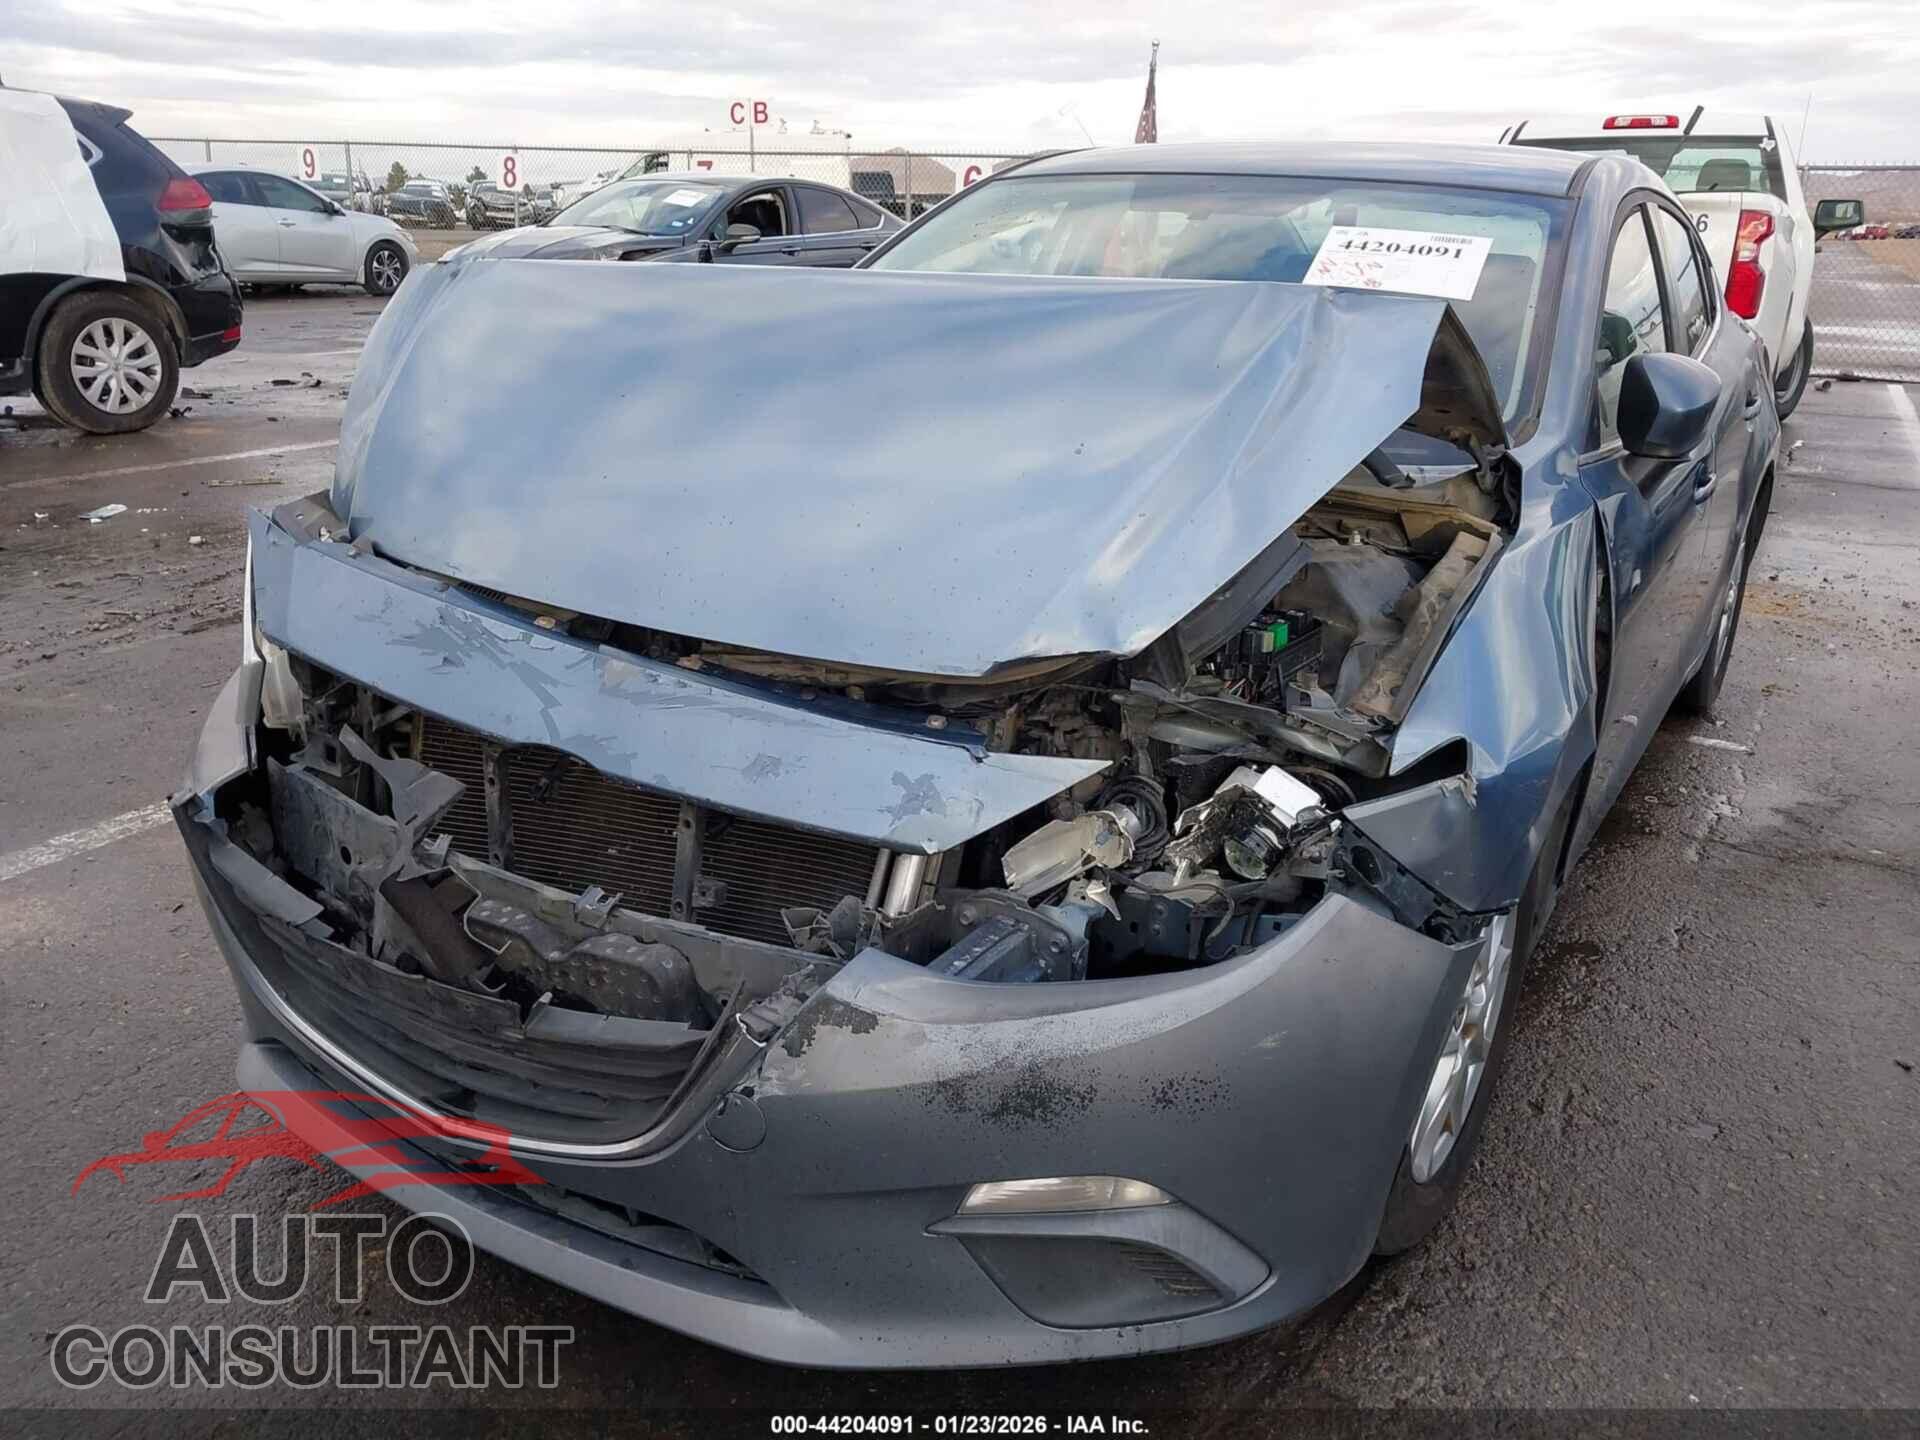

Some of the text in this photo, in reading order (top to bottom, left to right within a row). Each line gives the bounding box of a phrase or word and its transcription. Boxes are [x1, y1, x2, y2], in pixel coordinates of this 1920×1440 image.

[730, 102, 745, 124] C
[753, 102, 768, 124] B
[302, 148, 315, 178] 9
[503, 156, 516, 188] 8
[1690, 214, 1709, 233] 6
[1339, 239, 1463, 259] 44204091
